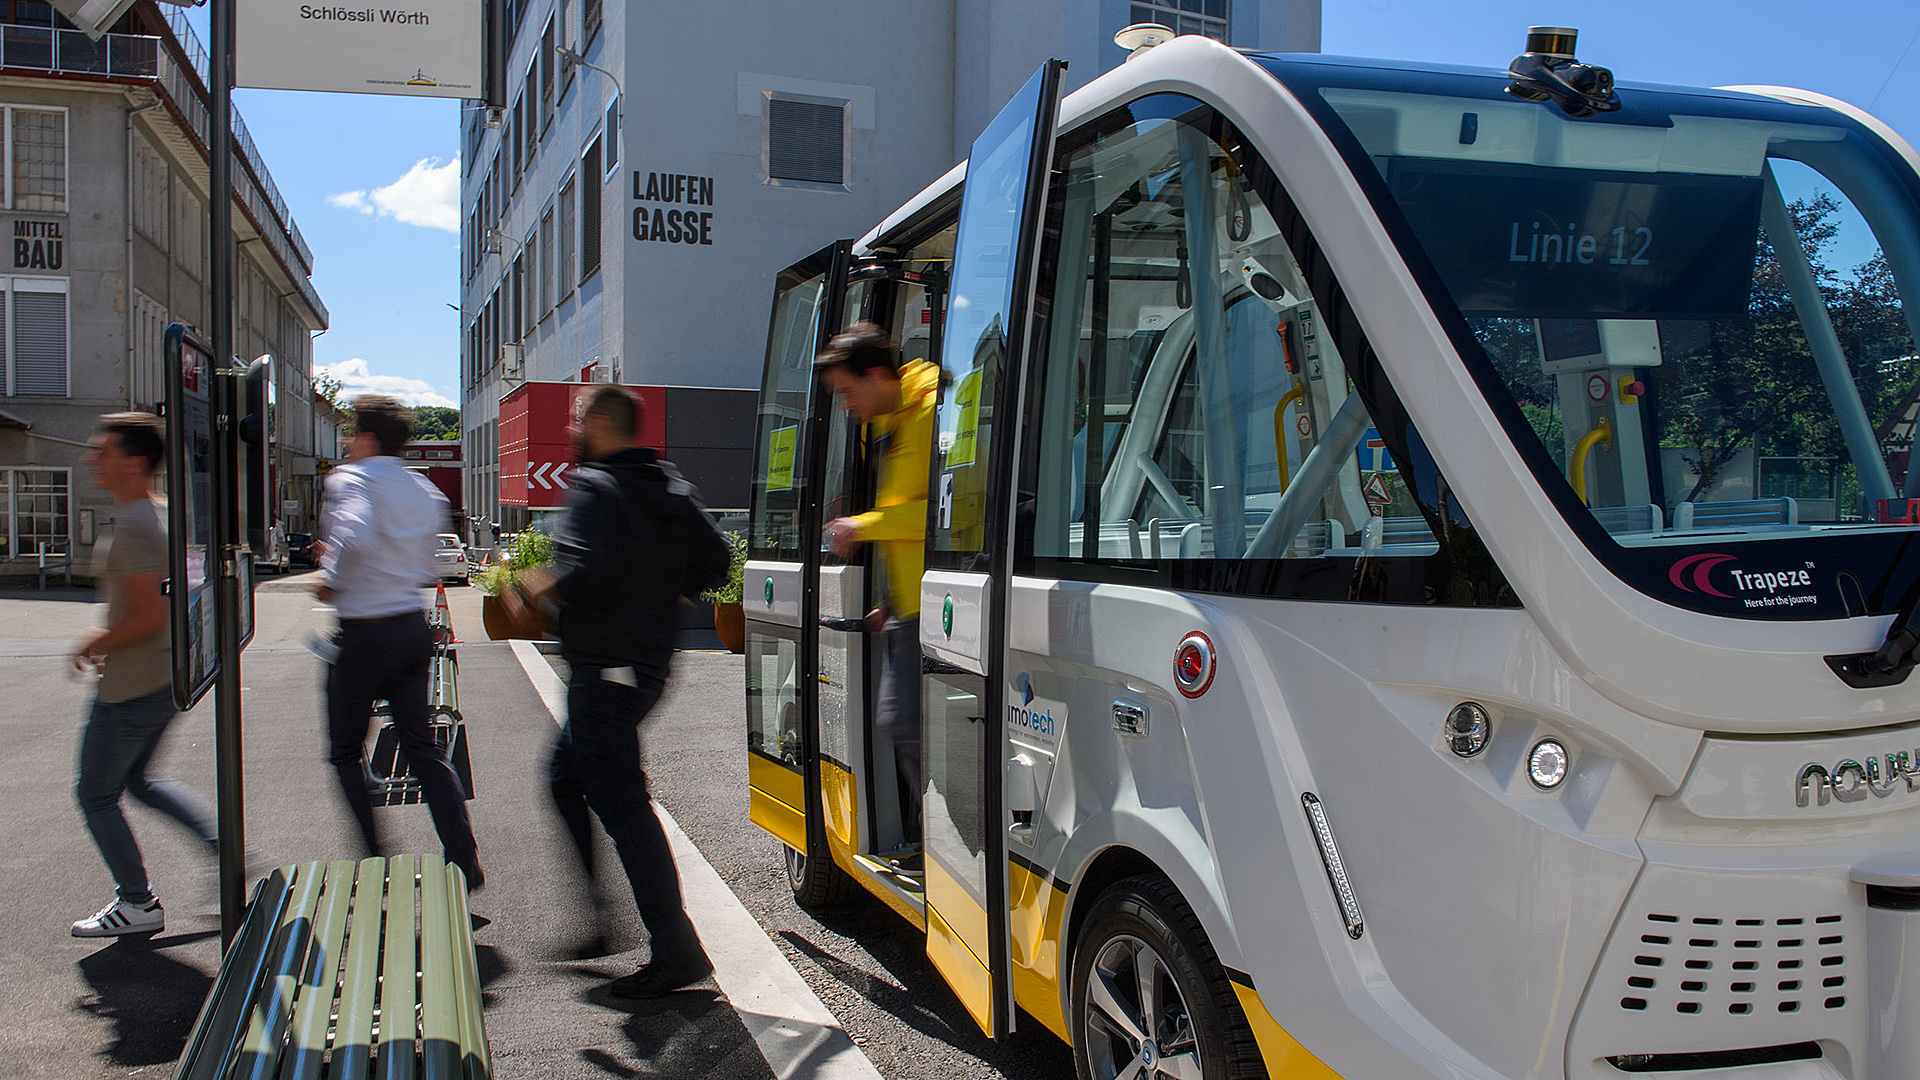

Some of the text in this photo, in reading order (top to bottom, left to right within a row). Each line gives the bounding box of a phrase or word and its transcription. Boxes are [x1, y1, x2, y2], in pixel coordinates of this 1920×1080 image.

[300, 5, 429, 25] Schlössli Wörth
[633, 170, 713, 206] LAUFEN
[14, 220, 62, 238] MITTEL
[633, 206, 713, 245] GASSE
[14, 238, 62, 270] BAU
[1509, 221, 1653, 265] Linie 12
[1730, 569, 1811, 593] Trapeze
[1744, 594, 1817, 608] Here for the journey
